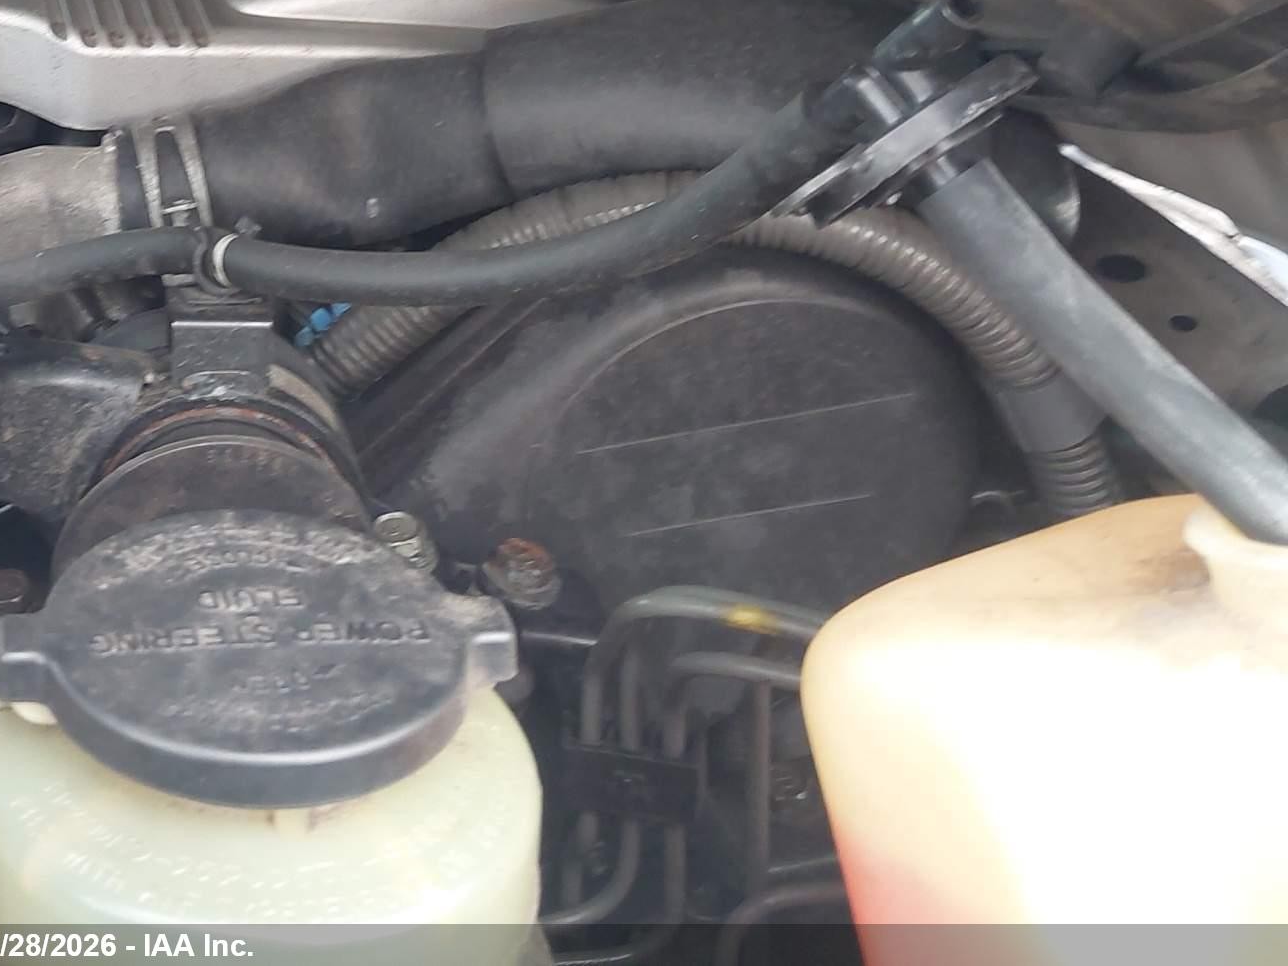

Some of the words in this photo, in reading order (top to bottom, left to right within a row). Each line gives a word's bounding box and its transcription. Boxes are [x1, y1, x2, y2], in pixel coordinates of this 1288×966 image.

[198, 587, 305, 613] FLUID
[91, 620, 278, 657] STEERING
[295, 621, 432, 645] POWER
